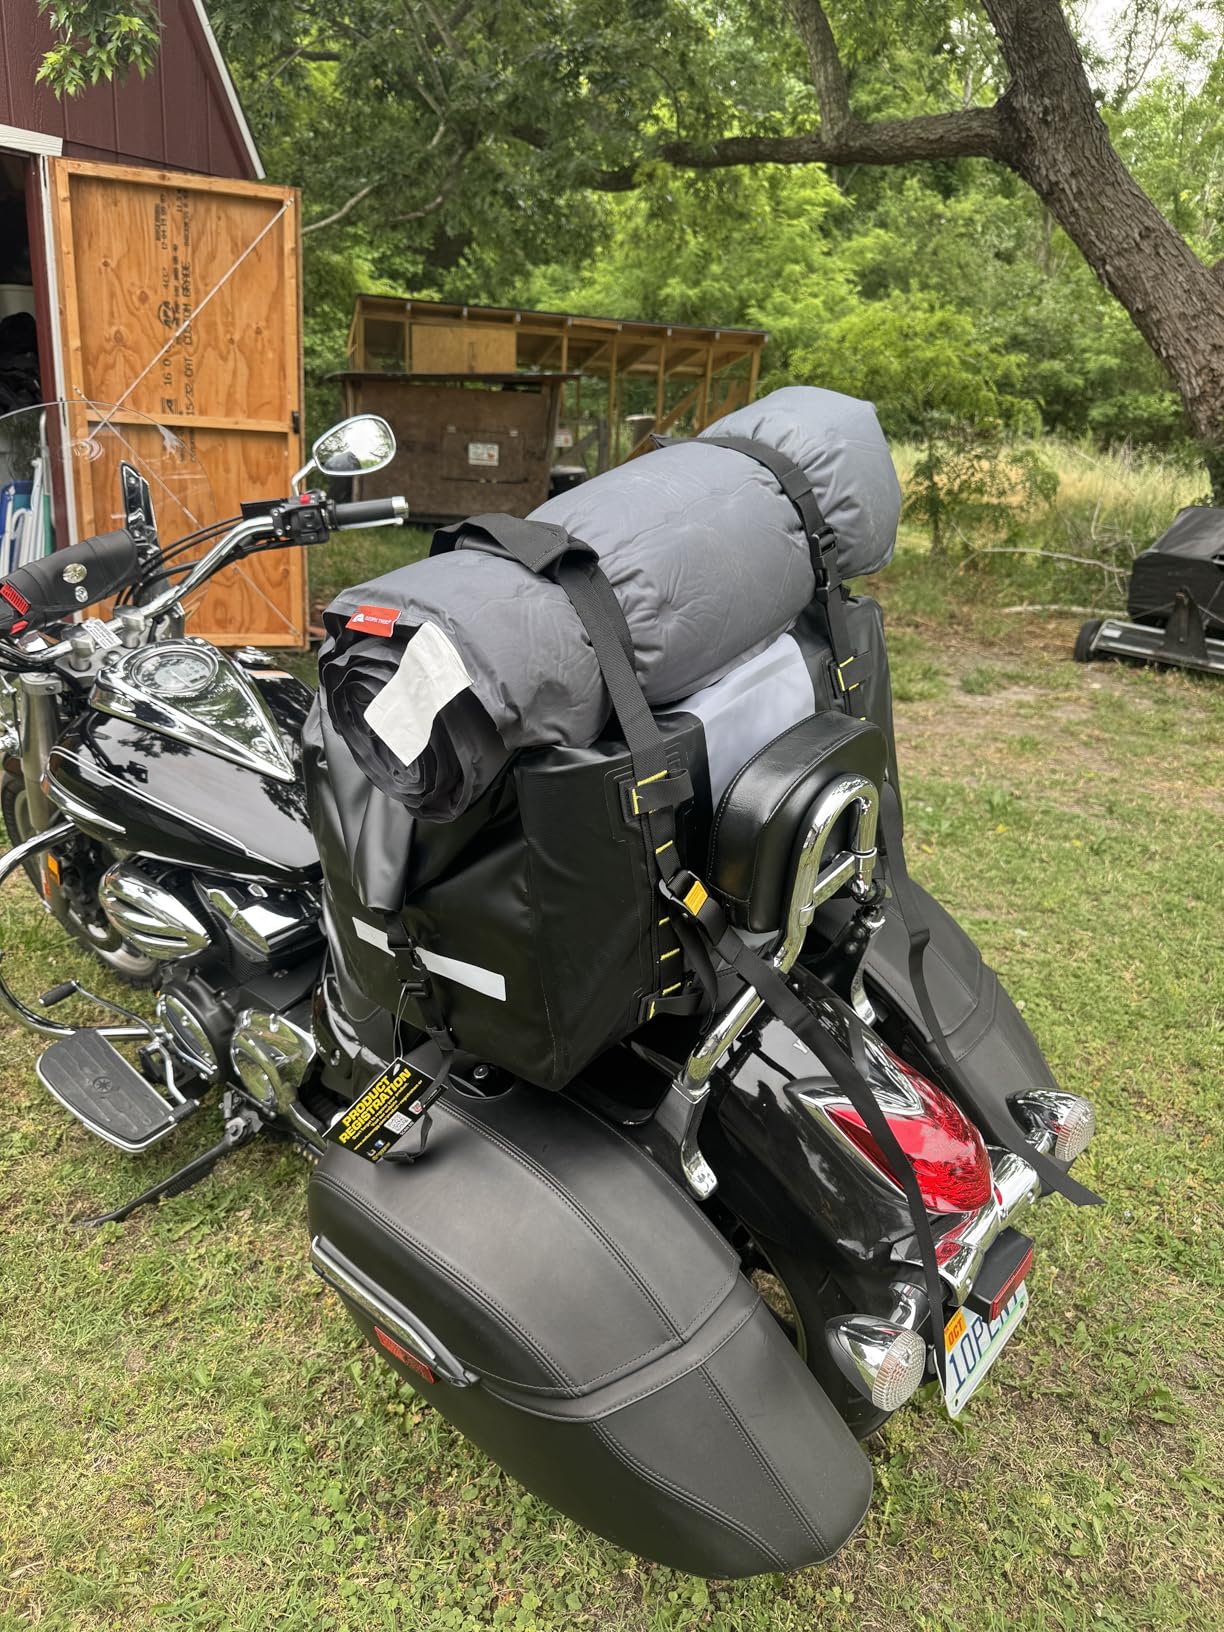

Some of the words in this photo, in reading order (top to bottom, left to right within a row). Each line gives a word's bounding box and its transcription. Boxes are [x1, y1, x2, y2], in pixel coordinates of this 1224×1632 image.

[163, 372, 173, 386] 16
[184, 357, 193, 378] CAT
[184, 382, 195, 416] 15/32
[338, 1067, 412, 1144] REGISTRATION
[341, 1075, 391, 1127] PRODUCT
[948, 1317, 963, 1346] OCT
